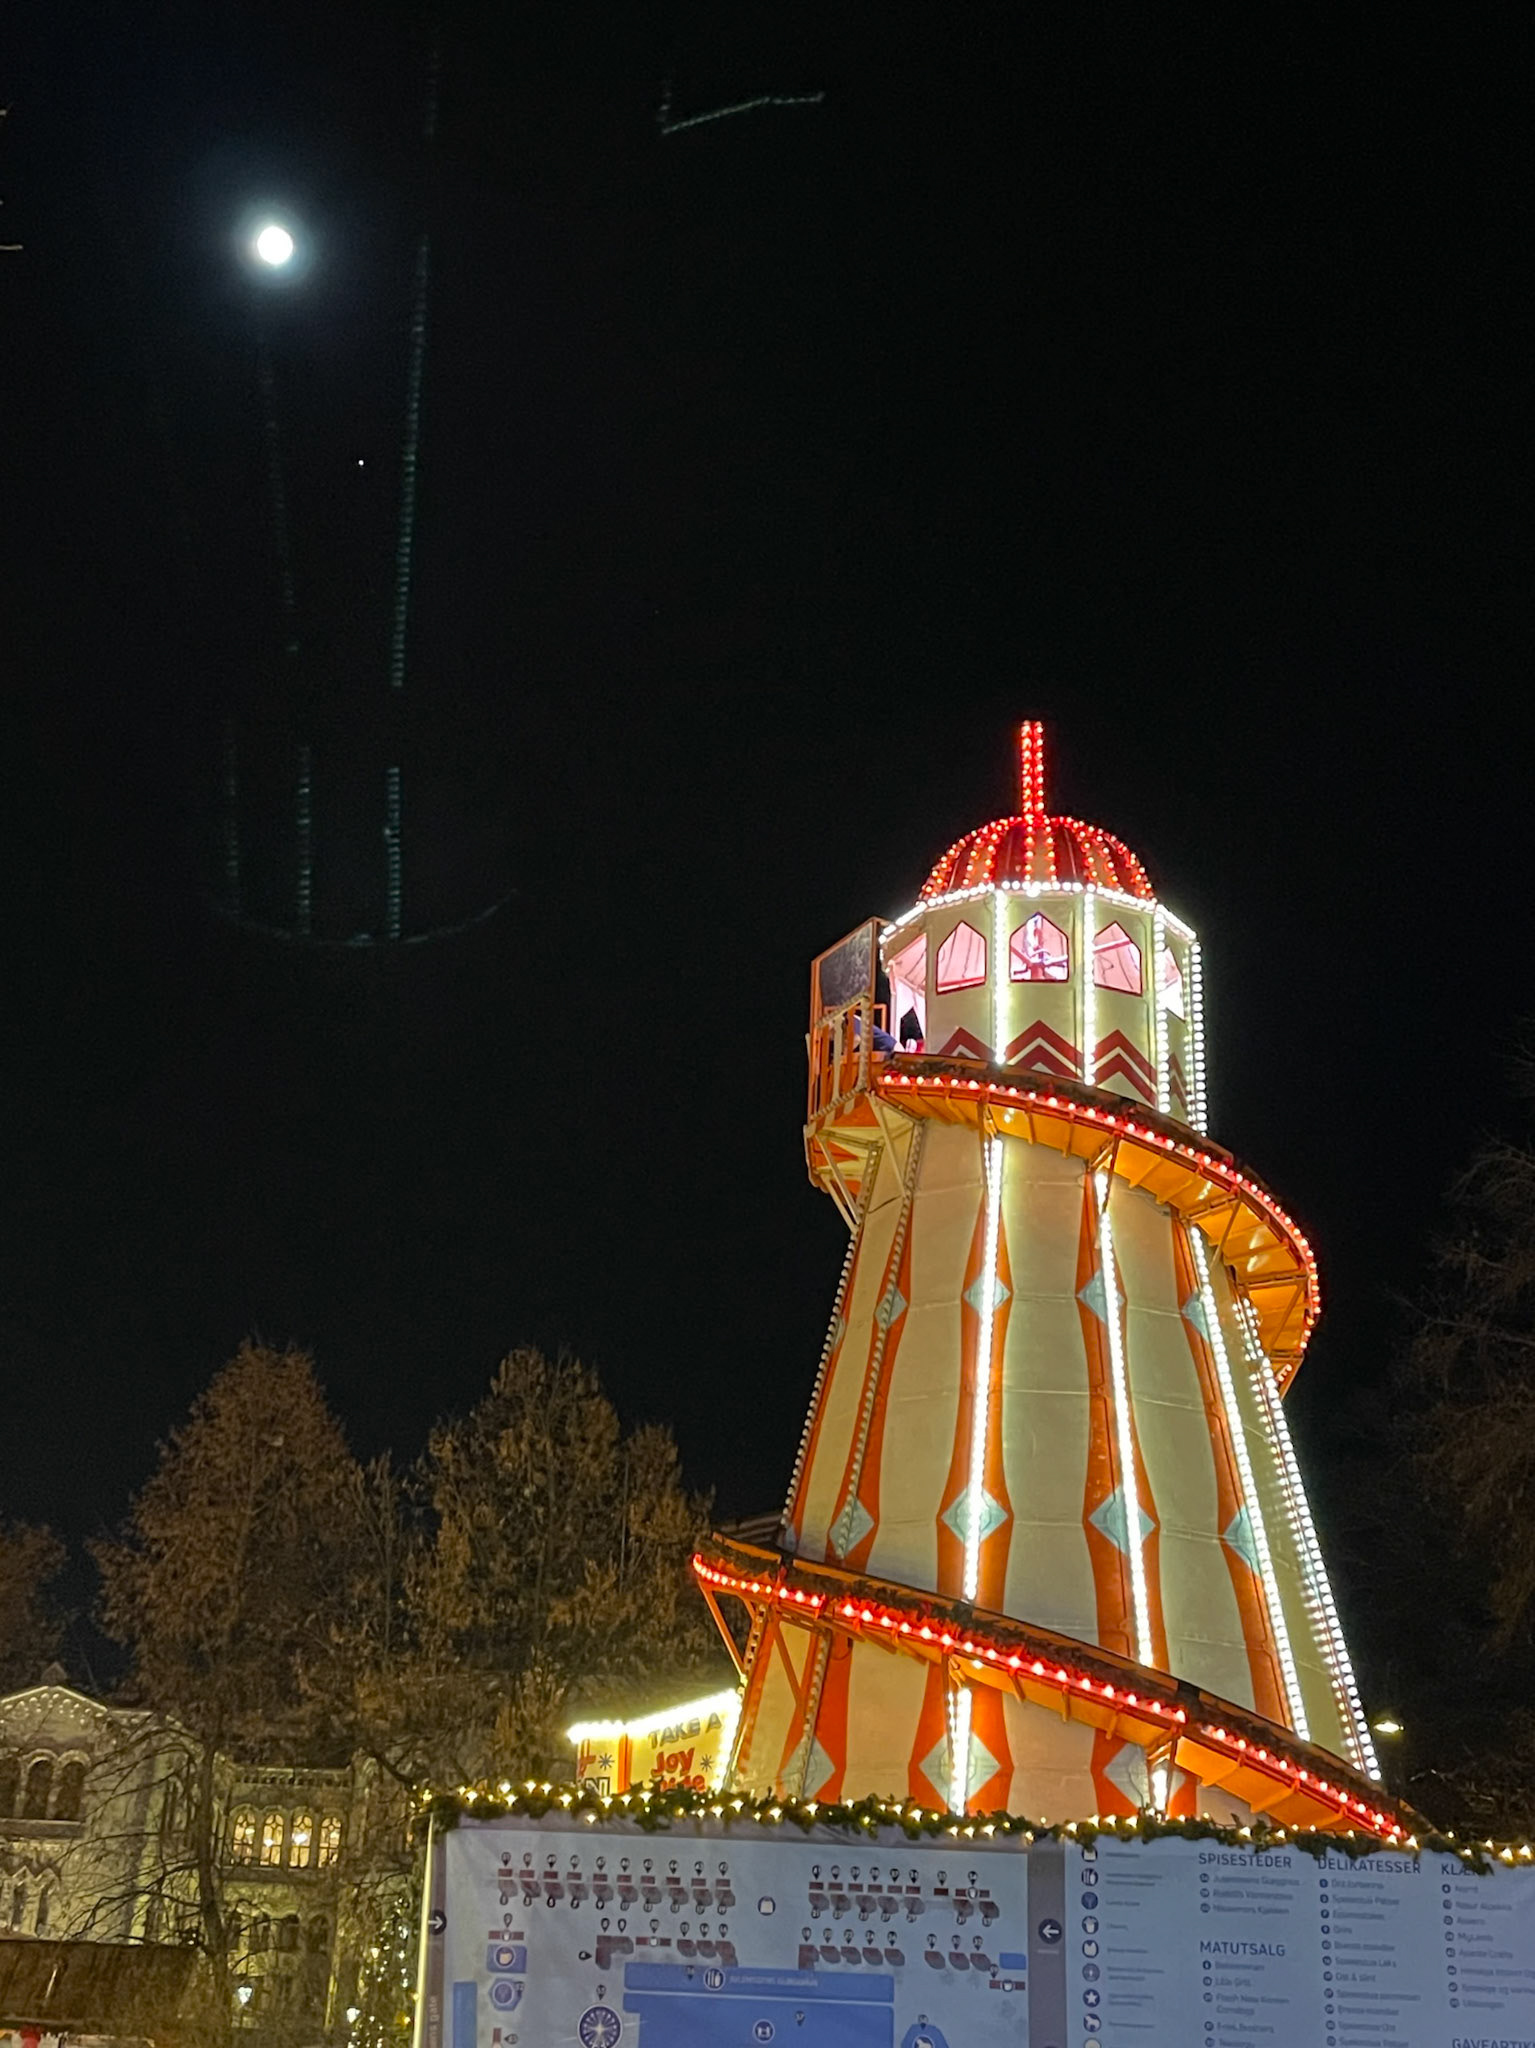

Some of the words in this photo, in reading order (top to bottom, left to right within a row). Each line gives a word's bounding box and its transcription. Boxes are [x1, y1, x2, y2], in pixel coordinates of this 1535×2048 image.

[648, 1718, 701, 1749] TAKE
[705, 1712, 721, 1733] A
[1198, 1852, 1292, 1868] SPISESTEDER
[1318, 1857, 1421, 1874] DELIKATESSER
[1441, 1863, 1480, 1876] KLÆ
[1200, 1941, 1286, 1957] MATUTSALG
